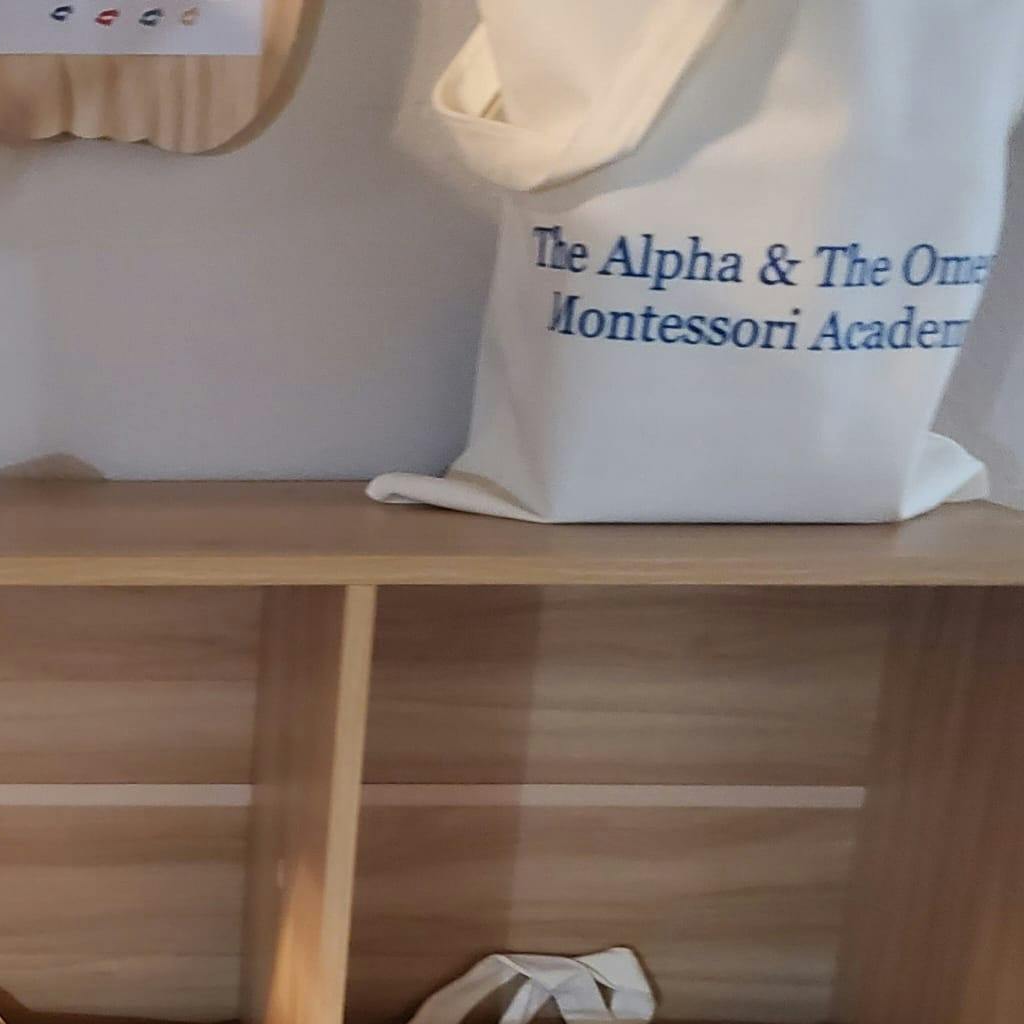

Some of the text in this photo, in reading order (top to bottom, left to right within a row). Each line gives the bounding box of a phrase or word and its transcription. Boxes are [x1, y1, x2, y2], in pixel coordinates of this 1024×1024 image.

[533, 226, 588, 272] The
[597, 233, 743, 291] Alpha
[758, 244, 800, 287] &
[816, 243, 891, 287] The
